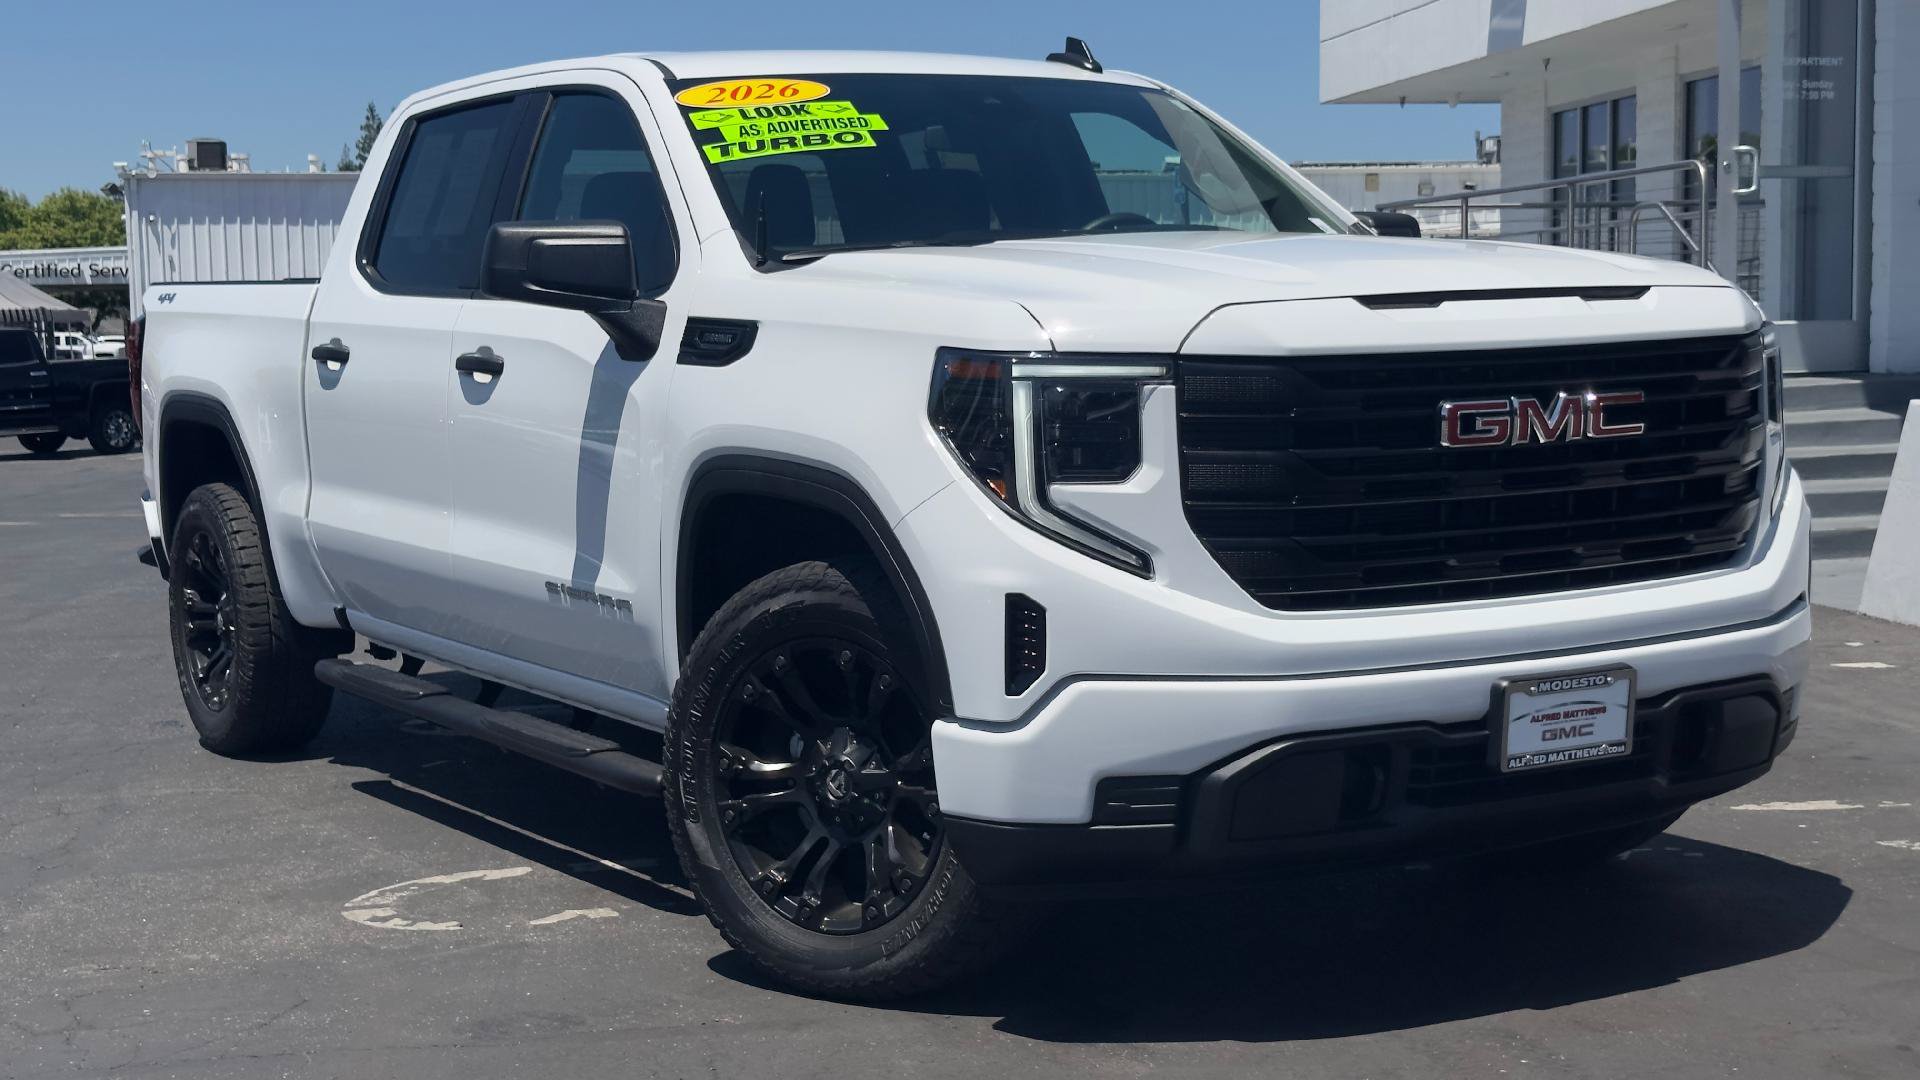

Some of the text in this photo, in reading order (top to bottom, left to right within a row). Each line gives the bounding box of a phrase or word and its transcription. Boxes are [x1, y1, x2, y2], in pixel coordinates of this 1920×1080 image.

[1785, 56, 1844, 66] EPARTMENT
[704, 82, 800, 104] 2026
[1801, 80, 1834, 90] Sunday
[1821, 91, 1835, 99] PM
[738, 103, 812, 121] LOOK
[739, 116, 869, 138] AS ADVERTISED
[711, 131, 866, 157] TURBO
[89, 263, 129, 278] Serv
[1439, 391, 1645, 447] GMC
[1538, 675, 1606, 692] MODESTO
[1530, 712, 1561, 724] ALFRED
[1563, 706, 1607, 719] MATTHEWS
[1542, 723, 1595, 741] GMC
[1508, 755, 1548, 769] ALFRED
